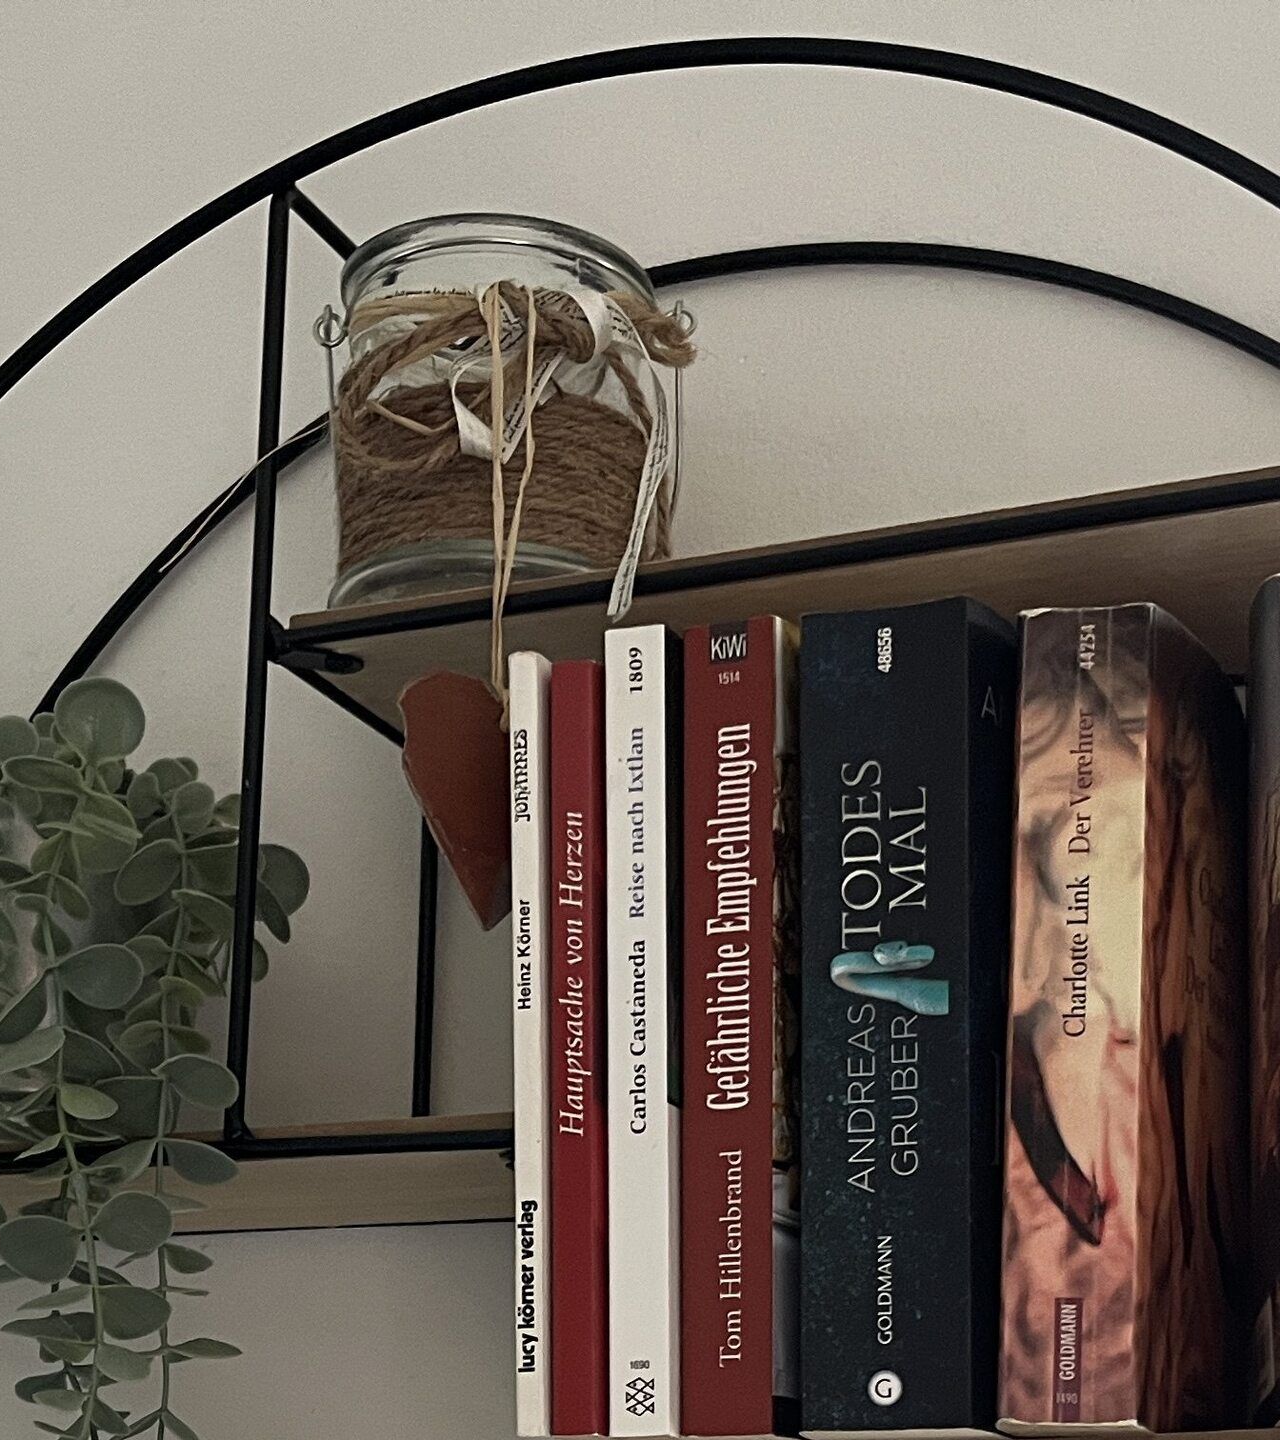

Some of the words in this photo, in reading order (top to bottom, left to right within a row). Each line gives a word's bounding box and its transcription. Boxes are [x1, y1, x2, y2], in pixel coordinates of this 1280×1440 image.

[629, 646, 644, 694] 1809
[711, 633, 747, 660] KiWi
[718, 671, 740, 685] 1514
[878, 627, 893, 673] 48656
[626, 727, 644, 795] Ixtlan
[1069, 709, 1094, 809] Verehrer
[559, 811, 584, 908] Herzen
[627, 801, 644, 853] nach
[706, 723, 757, 935] Empfehlungen
[841, 760, 882, 950] TODES
[888, 787, 926, 912] MAL
[1068, 812, 1092, 856] Der
[628, 862, 644, 918] Reise
[1066, 875, 1090, 925] Link
[516, 900, 532, 956] Körner
[565, 919, 584, 965] von
[517, 961, 533, 1009] Heinz
[628, 940, 646, 1056] Castaneda
[1063, 931, 1089, 1037] Charlotte
[559, 976, 592, 1136] Hauptsache
[706, 942, 750, 1110] Gefährliche
[629, 1063, 648, 1135] Carlos
[847, 1004, 876, 1193] ANDREAS
[891, 1015, 918, 1176] GRUBER
[518, 1199, 538, 1260] verlag
[719, 1149, 742, 1300] Hillenbrand
[877, 1236, 892, 1345] GOLDMANN
[518, 1334, 539, 1374] lucy
[719, 1310, 741, 1369] Tom
[1059, 1303, 1077, 1381] GOLDMANN
